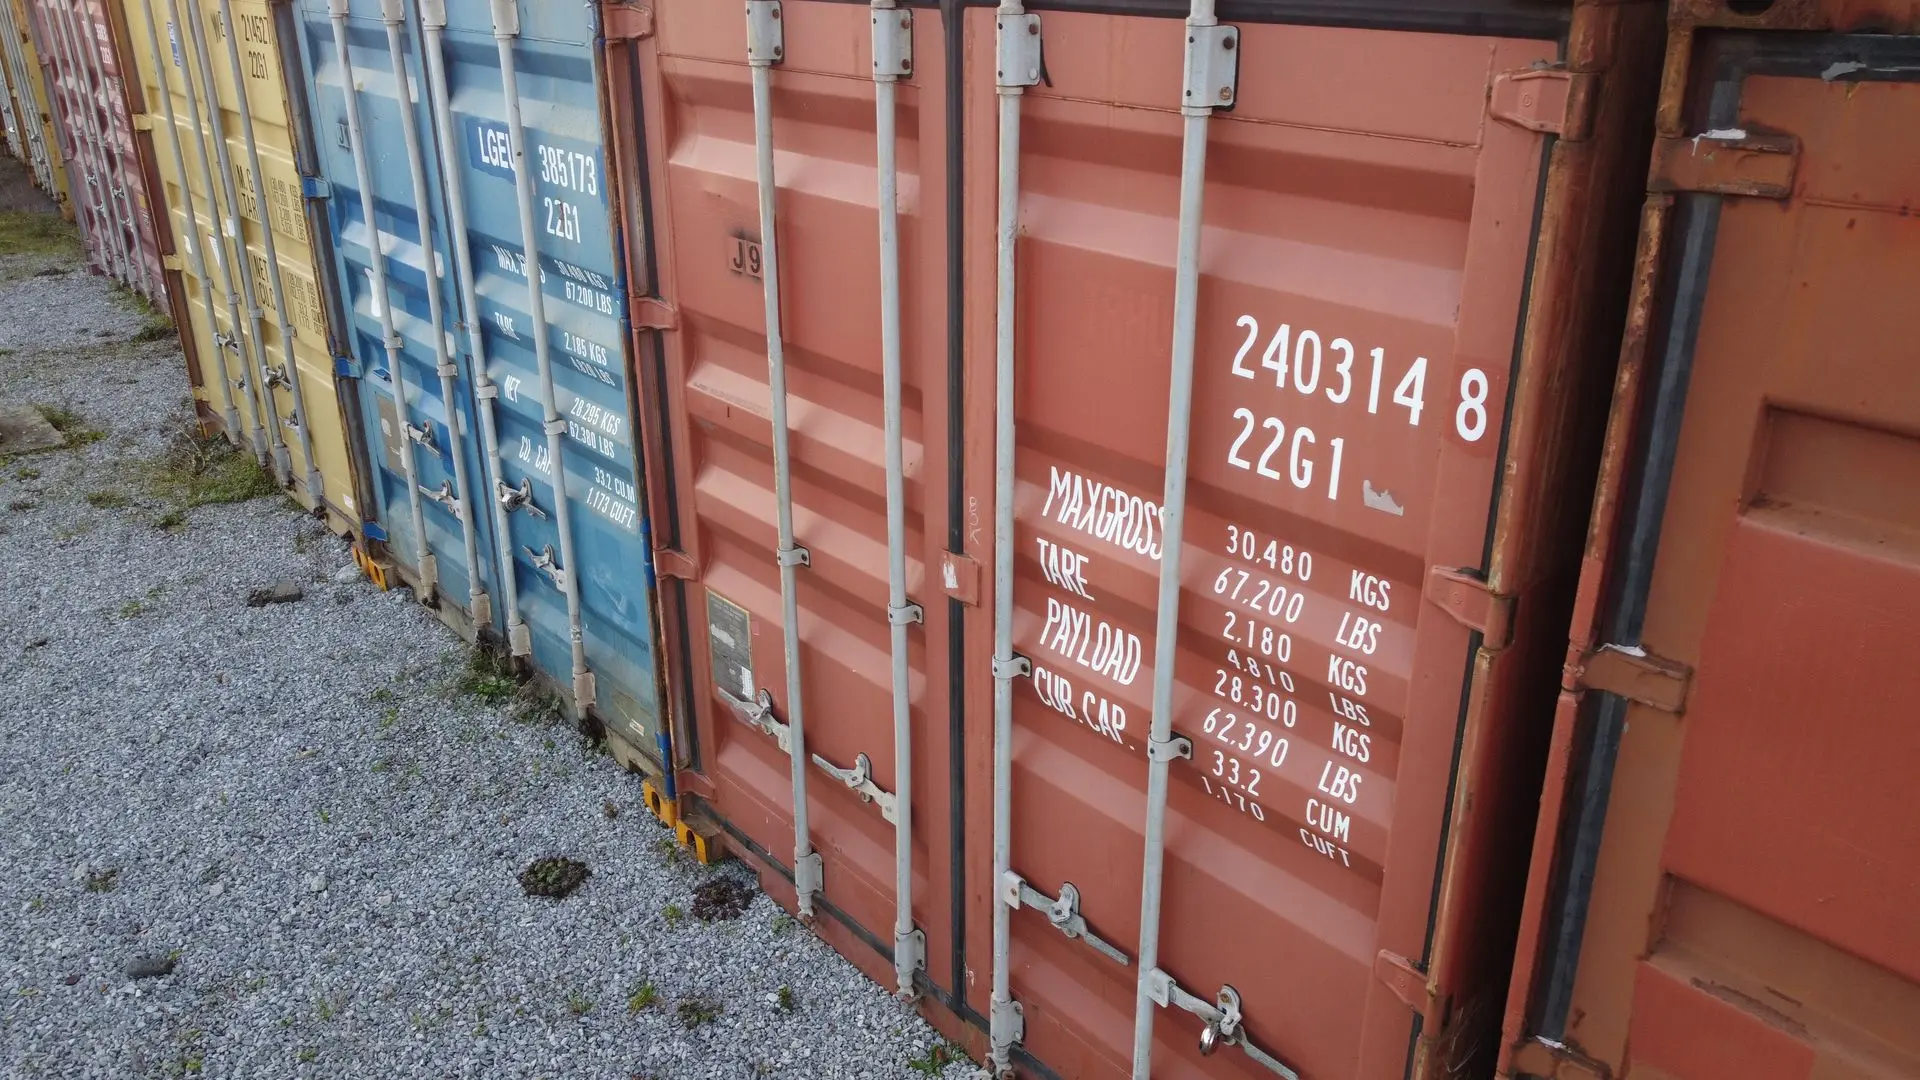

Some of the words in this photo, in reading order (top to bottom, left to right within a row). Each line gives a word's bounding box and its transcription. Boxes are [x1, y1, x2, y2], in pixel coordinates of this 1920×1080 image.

[538, 144, 597, 196] 385173
[241, 193, 259, 220] TAR
[544, 197, 581, 243] 22G1
[733, 241, 760, 273] J9
[596, 292, 613, 315] LBS
[589, 343, 607, 366] KGS
[1231, 314, 1428, 426] 240314
[1455, 368, 1489, 442] 8
[504, 374, 521, 403] NET
[600, 411, 621, 436] KGS
[599, 435, 615, 459] LBS
[1227, 407, 1344, 500] 22G1
[586, 487, 609, 513] 1.173
[594, 466, 612, 491] 33.2
[1042, 466, 1165, 560] MAXGROSS
[1350, 569, 1391, 611] KGS
[1036, 537, 1095, 601] TARE
[1327, 654, 1368, 696] KGS
[1336, 612, 1382, 655] LBS
[1039, 597, 1142, 686] PAYLOAD
[1332, 722, 1371, 763] KGS
[1329, 692, 1371, 726] LBS
[1212, 750, 1260, 796] 33.2
[1306, 798, 1350, 843] CUM
[1318, 760, 1362, 804] LBS
[1201, 776, 1265, 821] 1.170
[1300, 827, 1350, 868] CUFT
